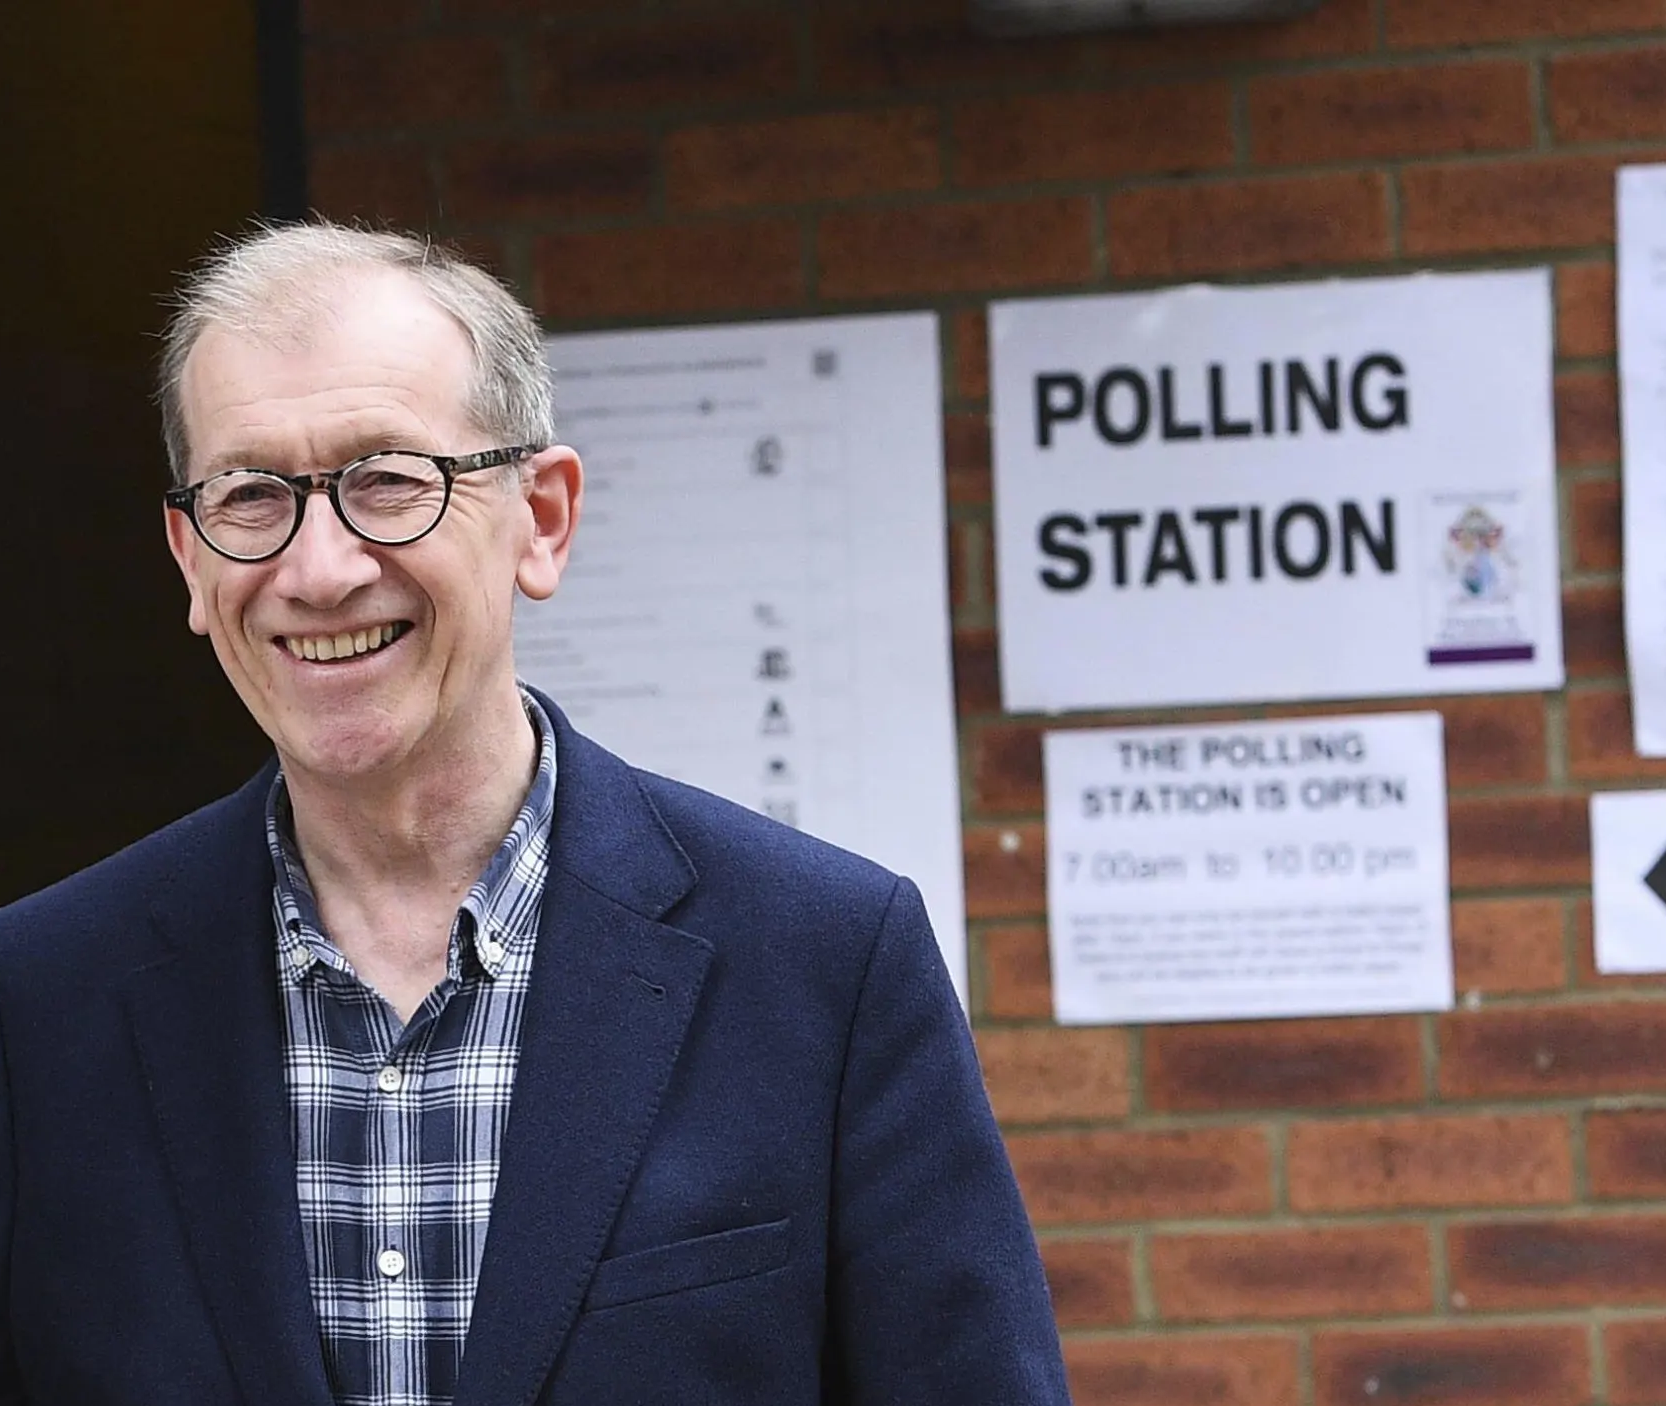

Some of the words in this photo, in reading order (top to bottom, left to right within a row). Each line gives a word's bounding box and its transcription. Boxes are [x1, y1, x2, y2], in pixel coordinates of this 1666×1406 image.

[1035, 352, 1409, 447] POLLING
[1039, 498, 1396, 592] STATION
[1117, 739, 1186, 771] THE
[1199, 733, 1366, 767] POLLING
[1081, 782, 1243, 817] STATION
[1254, 780, 1286, 810] IS
[1299, 775, 1407, 810] OPEN
[1205, 850, 1239, 878] to
[1364, 846, 1414, 877] pm
